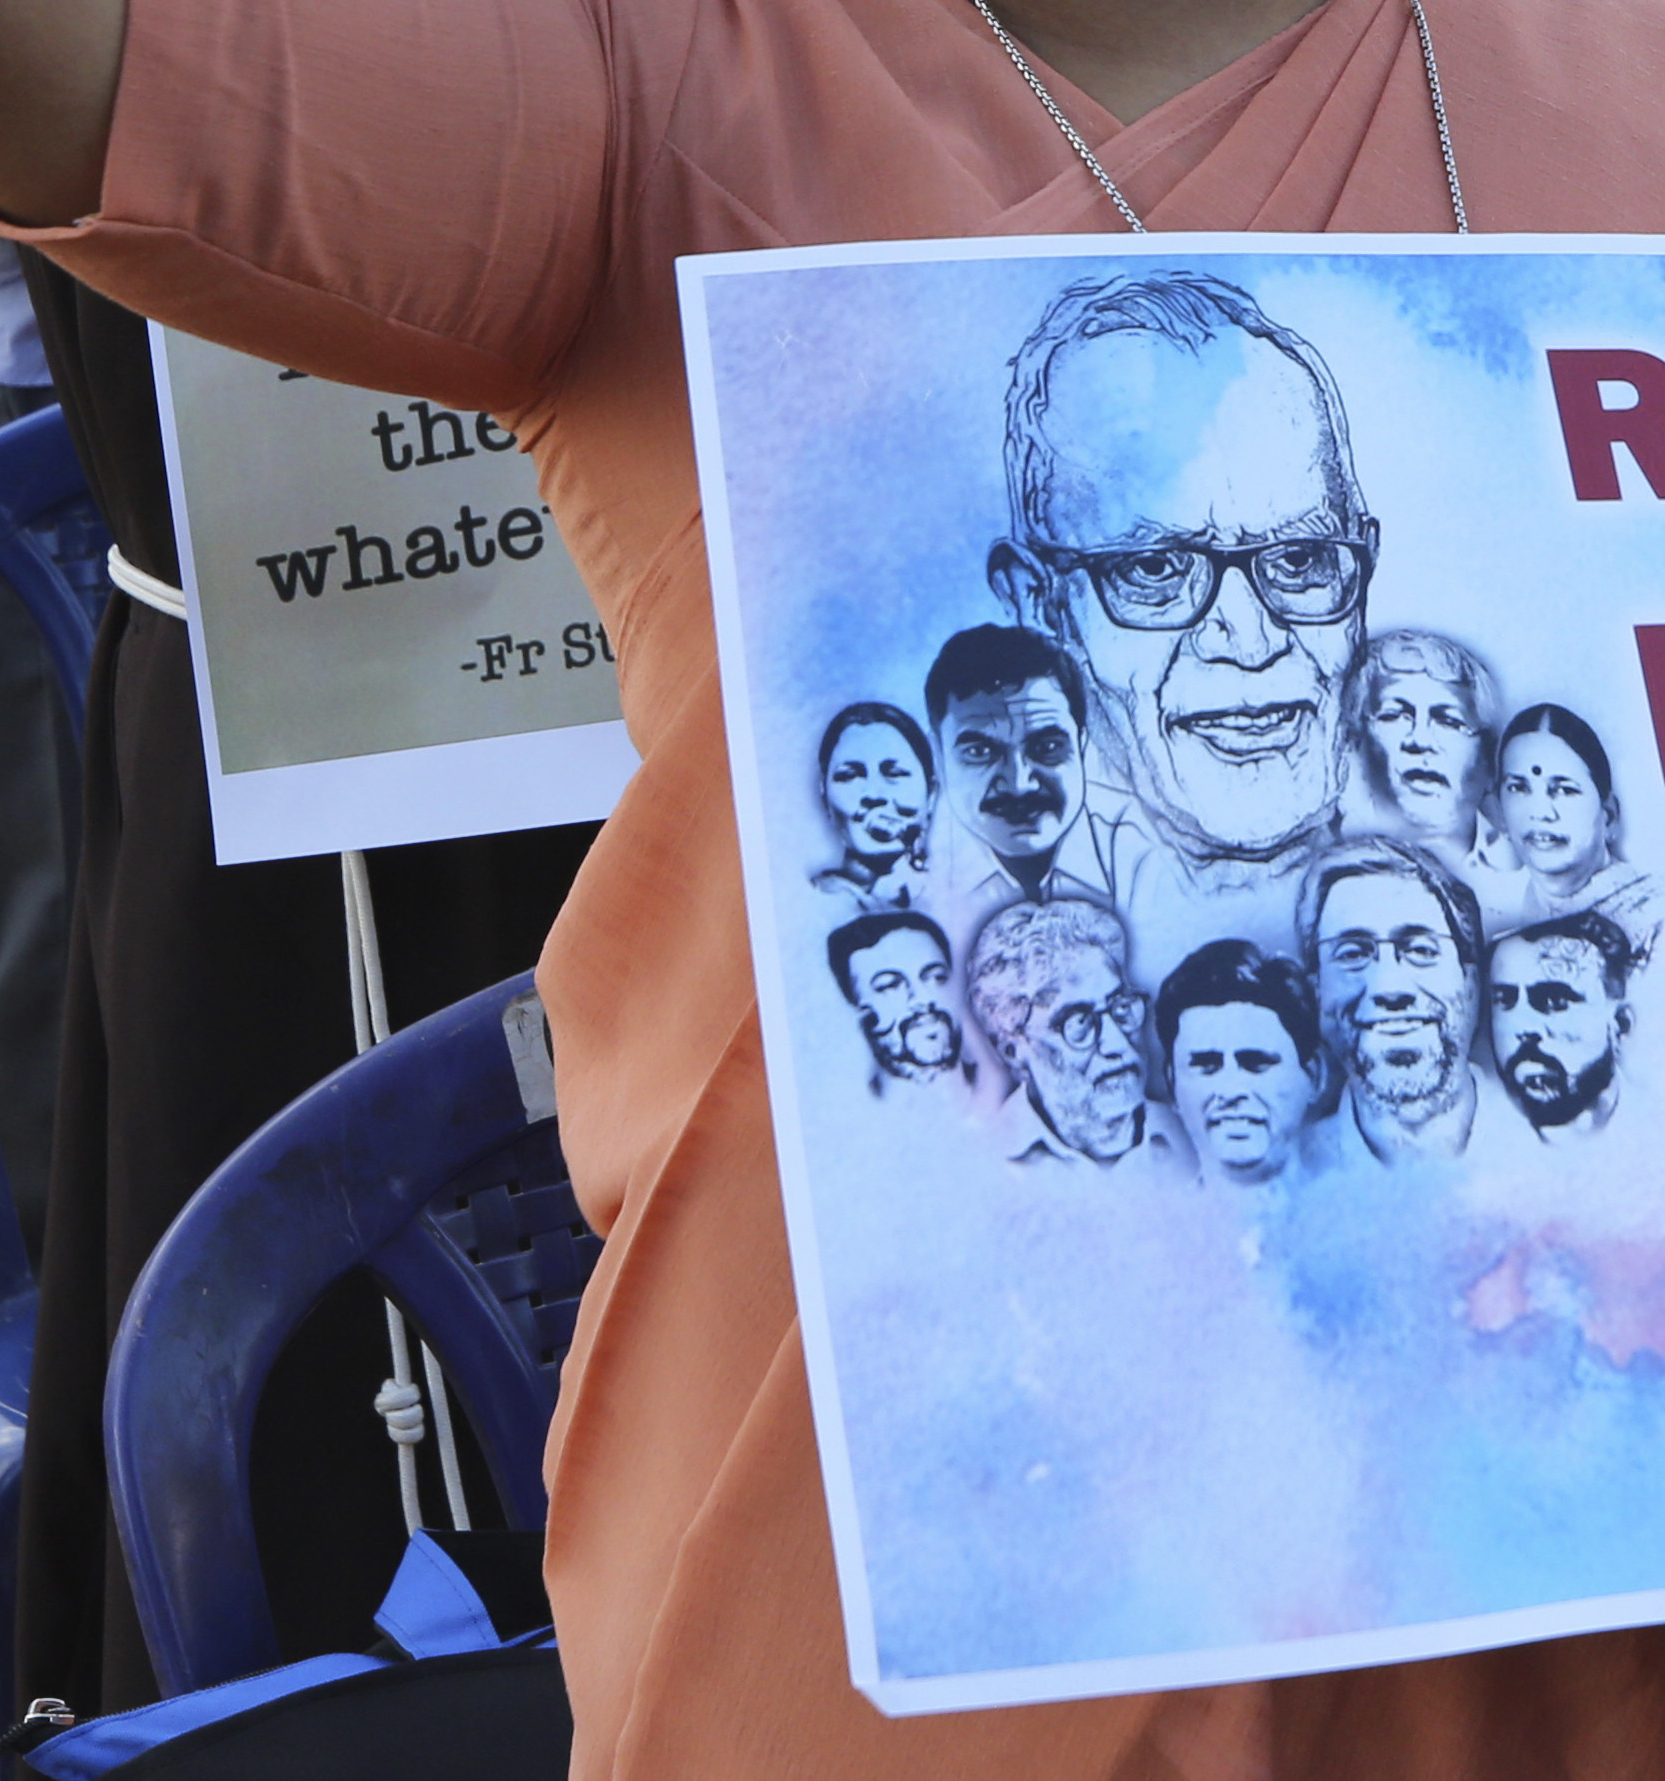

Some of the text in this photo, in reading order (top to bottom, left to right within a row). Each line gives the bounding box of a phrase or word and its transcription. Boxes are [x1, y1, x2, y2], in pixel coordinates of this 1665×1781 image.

[370, 399, 518, 472] the
[254, 504, 552, 603] whate
[460, 634, 546, 683] -Fr
